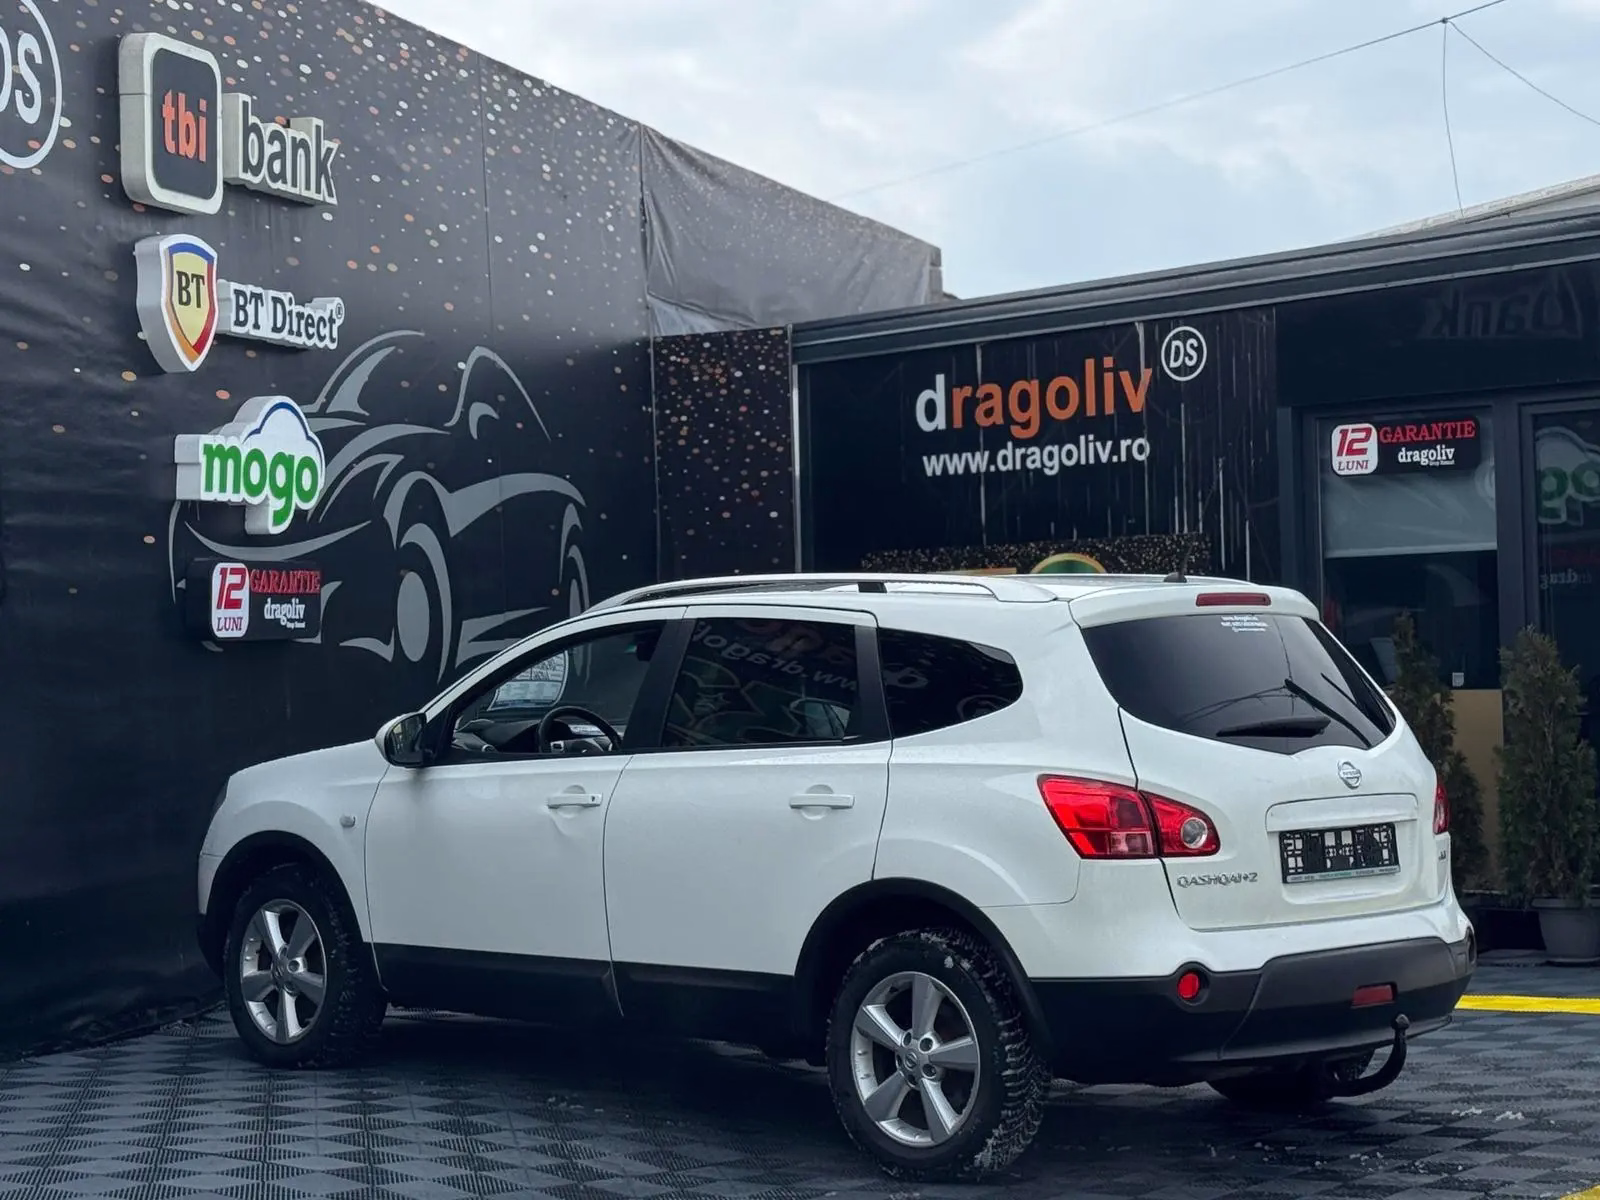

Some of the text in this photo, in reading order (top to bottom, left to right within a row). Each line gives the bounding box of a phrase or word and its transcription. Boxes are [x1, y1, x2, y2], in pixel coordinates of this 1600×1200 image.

[162, 90, 207, 163] tbi
[241, 99, 339, 201] bank
[176, 270, 205, 309] BT
[233, 288, 264, 330] BT
[1169, 338, 1198, 368] DS
[915, 356, 1153, 439] dragoliv
[922, 433, 1151, 477] www.dragoliv.ro
[1336, 419, 1476, 457] 12 GARANTIE
[1398, 444, 1455, 466] dragoliv
[203, 443, 318, 526] mogo
[1337, 459, 1370, 472] LUNI
[216, 567, 321, 610] 12 GARANTIE
[216, 616, 243, 632] LUNI
[264, 597, 305, 626] dragoliv
